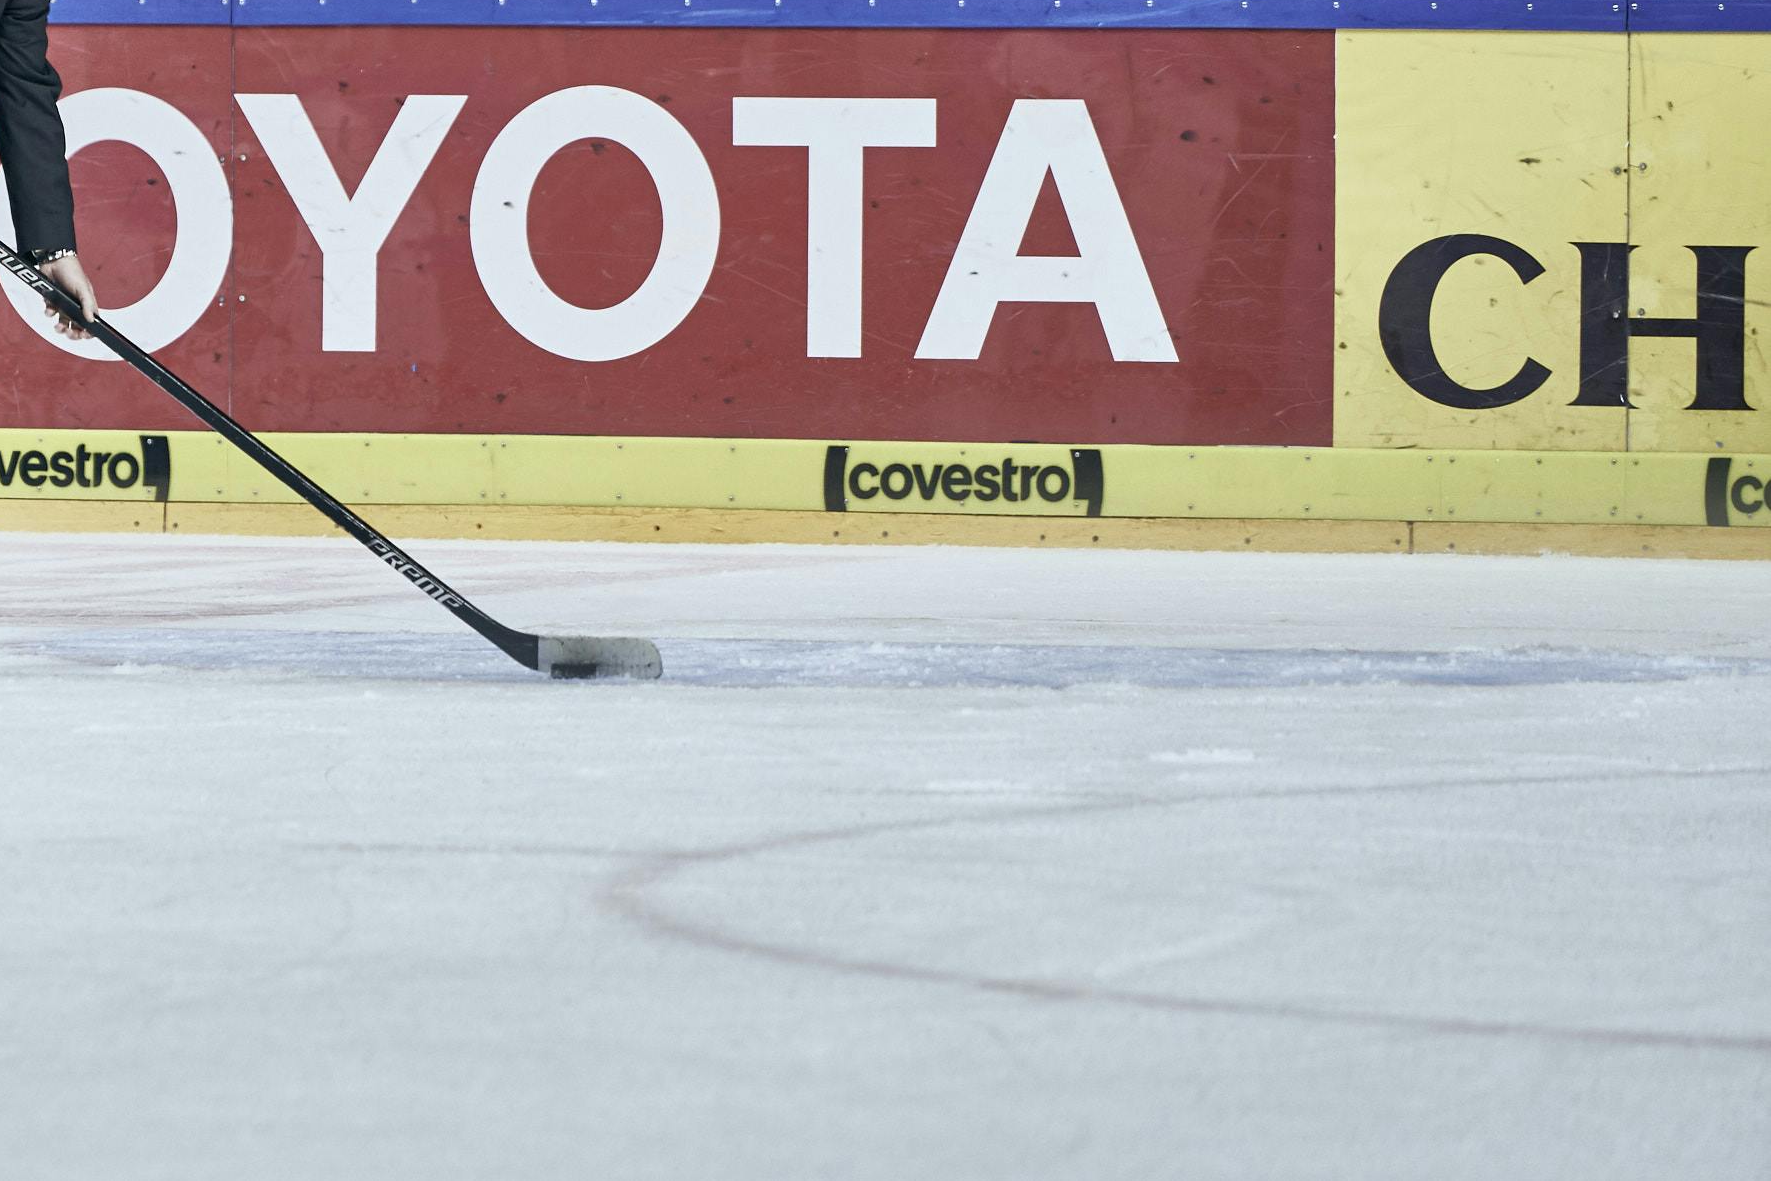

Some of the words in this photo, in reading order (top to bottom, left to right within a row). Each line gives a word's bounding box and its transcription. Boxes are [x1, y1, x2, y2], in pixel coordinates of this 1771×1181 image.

[1378, 233, 1758, 412] CH
[848, 457, 1070, 503] covestro
[1730, 475, 1771, 514] c
